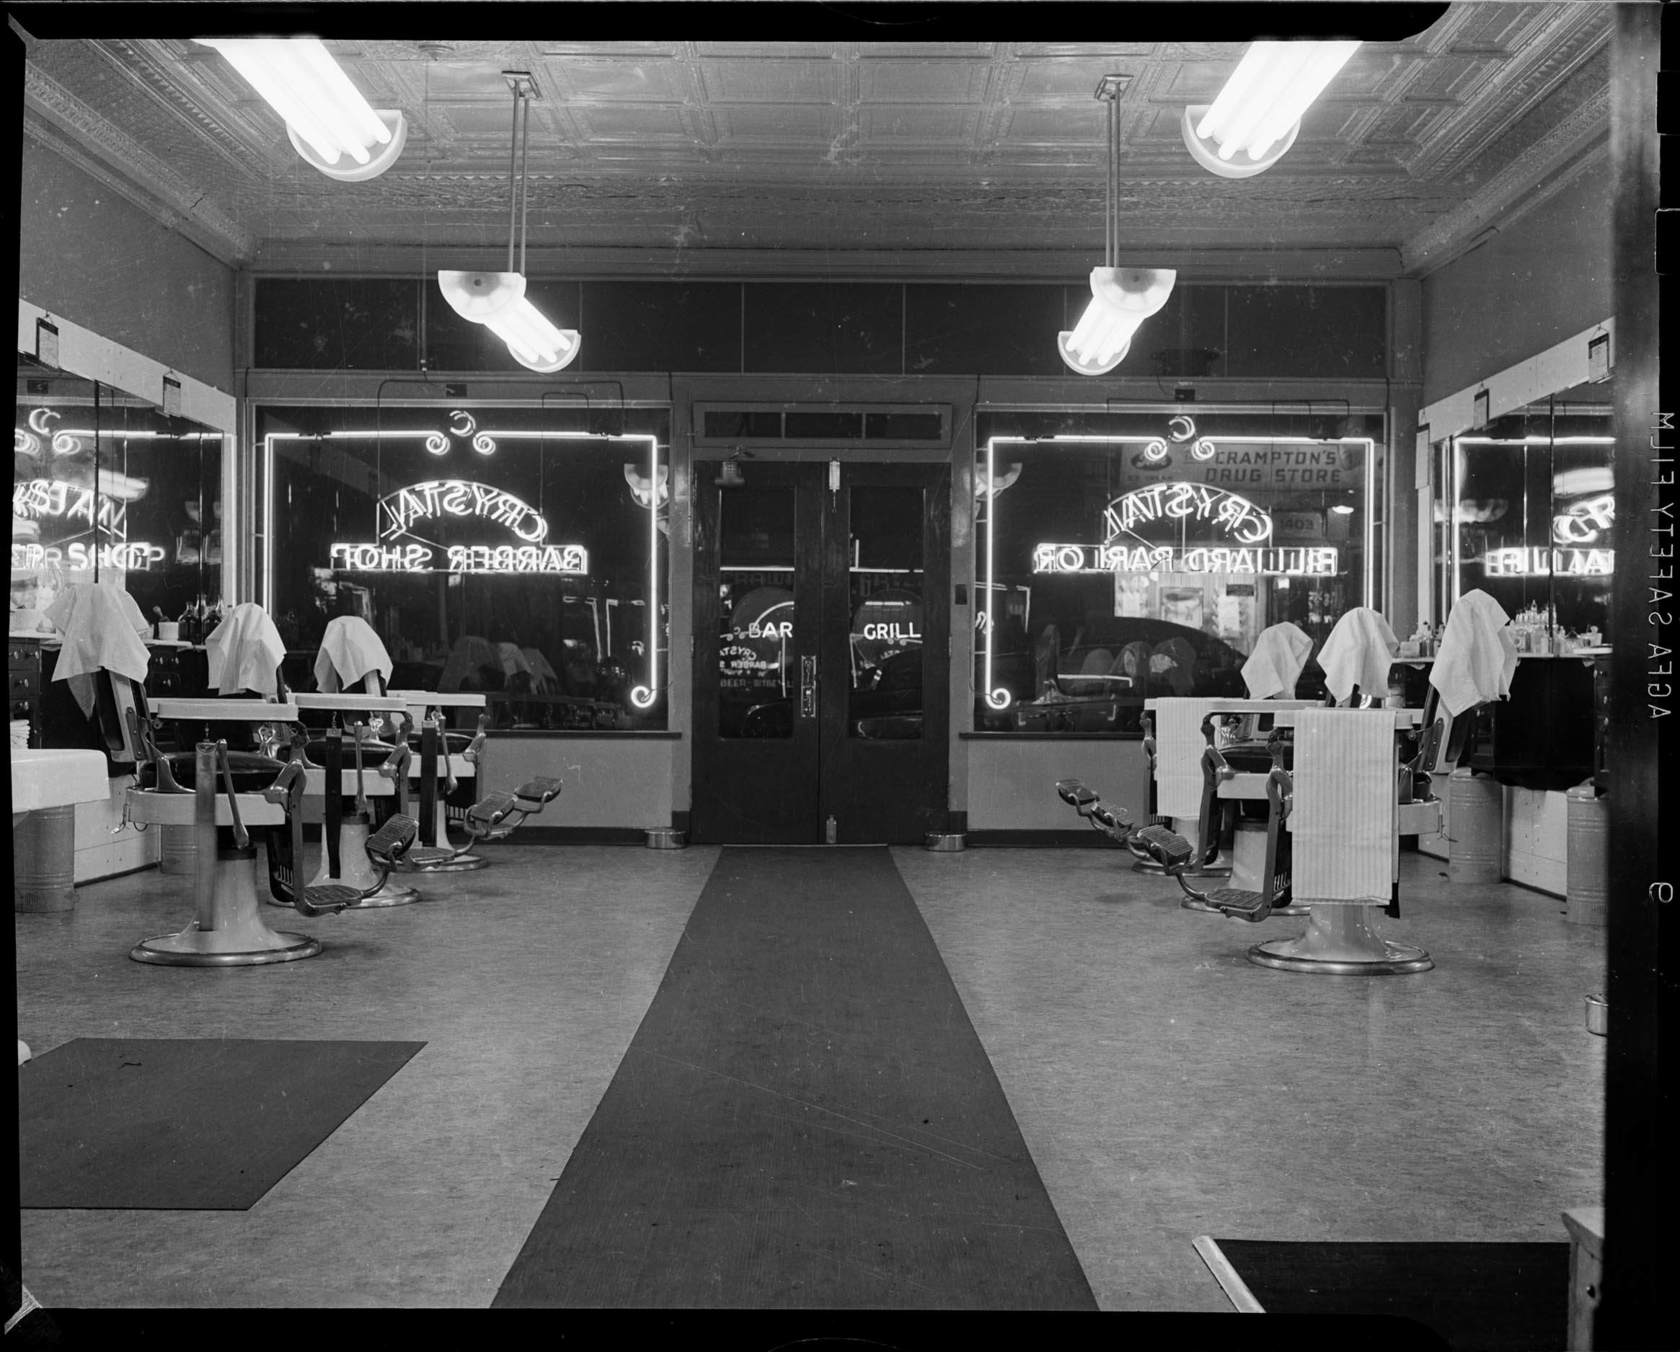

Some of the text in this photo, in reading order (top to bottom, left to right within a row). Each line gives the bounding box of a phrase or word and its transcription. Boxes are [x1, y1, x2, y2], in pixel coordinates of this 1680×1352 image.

[1214, 450, 1338, 466] CRAMPTON'S
[1204, 467, 1343, 483] DRUG STORE
[748, 621, 794, 639] BAR
[863, 621, 923, 640] GRILL
